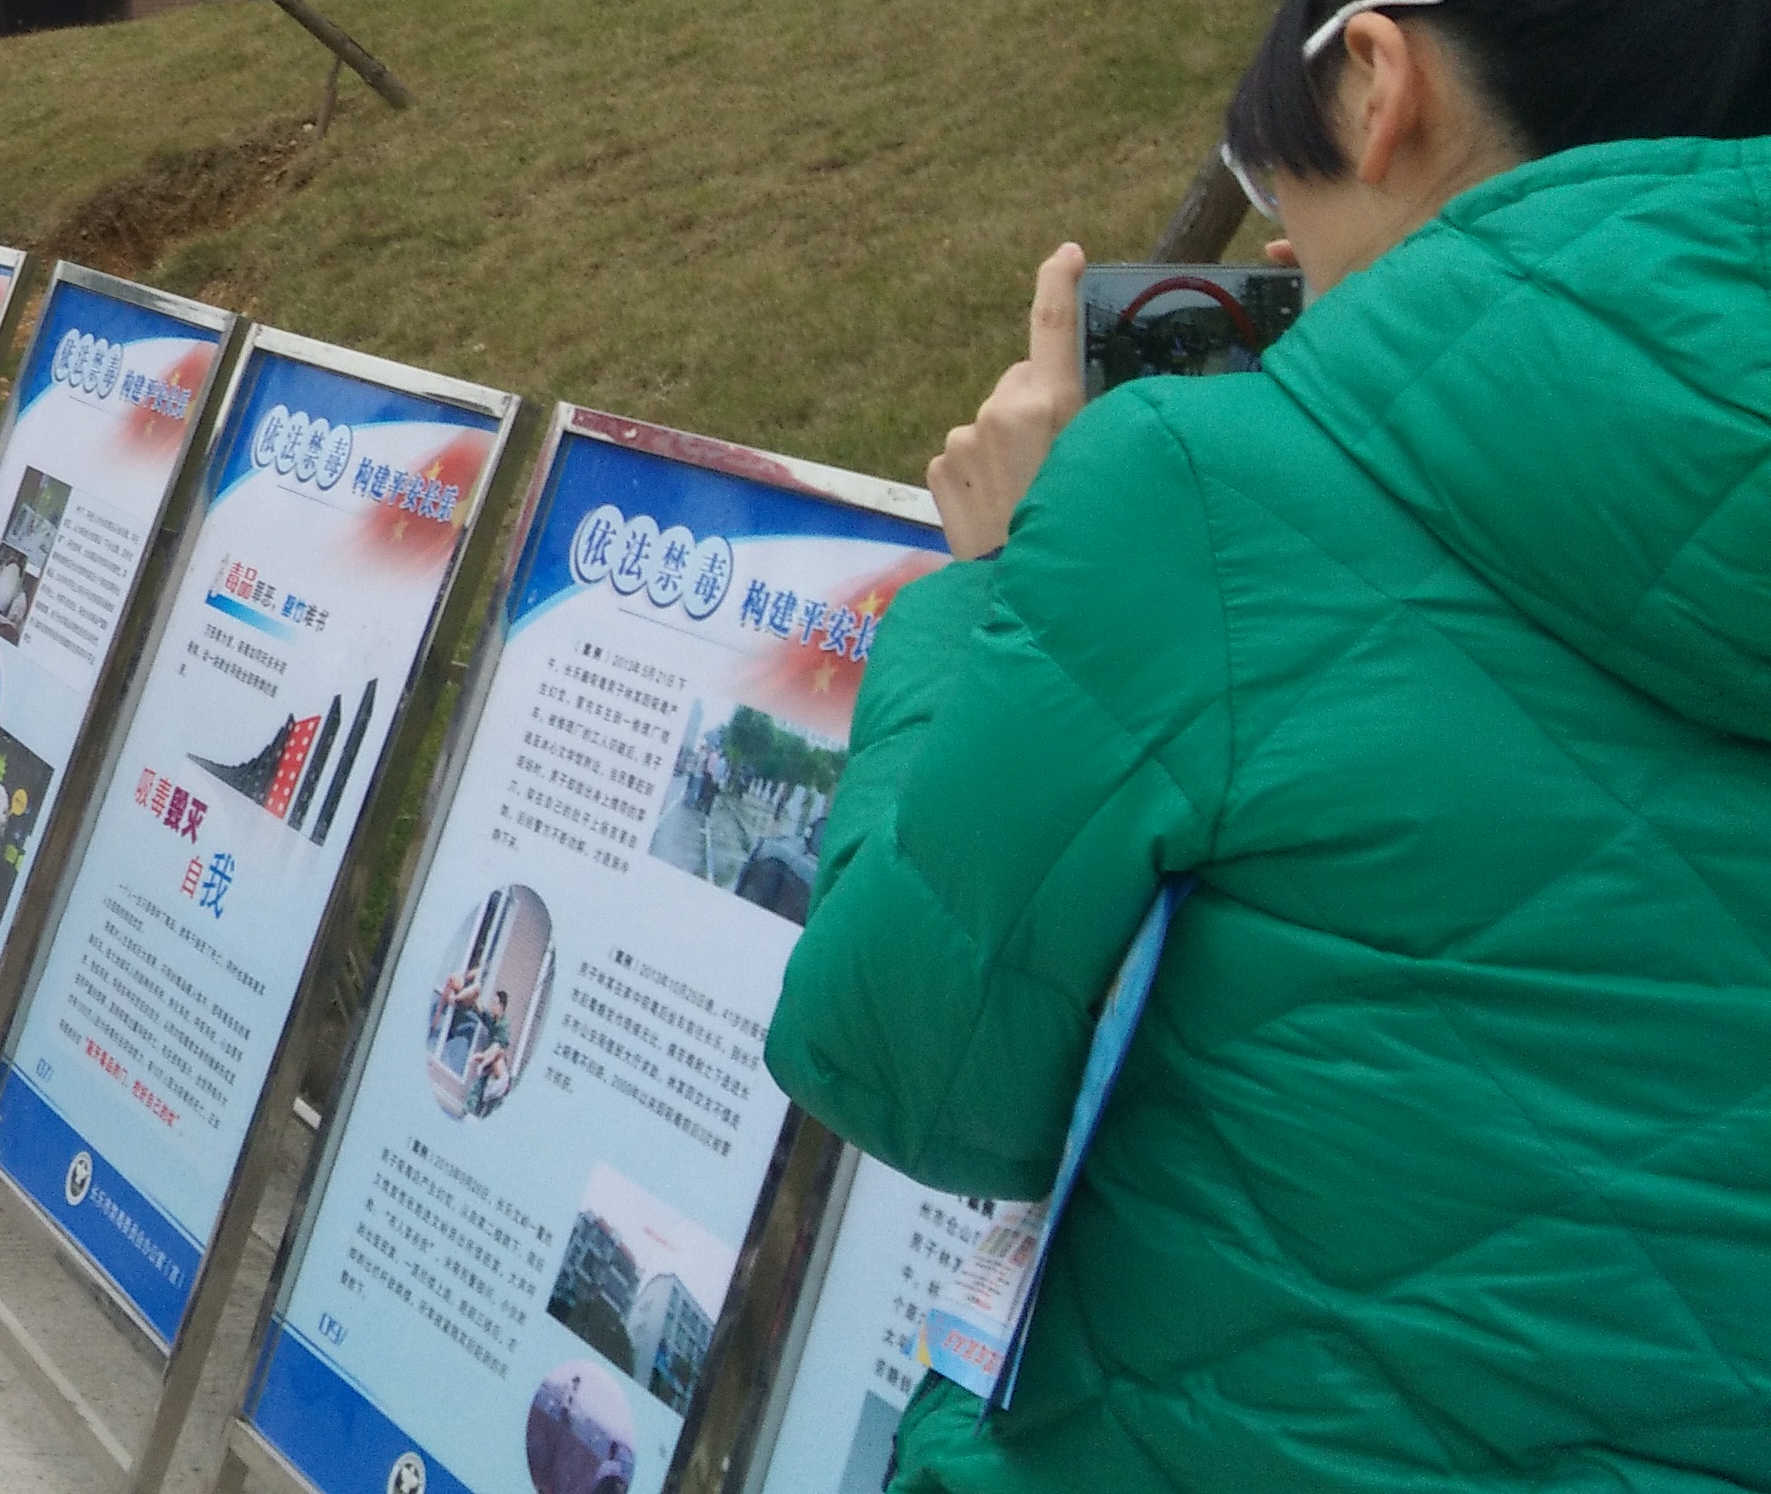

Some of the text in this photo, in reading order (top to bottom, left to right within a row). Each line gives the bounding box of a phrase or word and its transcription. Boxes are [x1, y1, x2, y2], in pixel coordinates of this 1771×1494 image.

[259, 416, 459, 524] 依法禁毒 构建平安长乐
[582, 517, 728, 606] 依法禁毒
[134, 767, 208, 844] 吸毒毁灭
[180, 853, 235, 919] 自我
